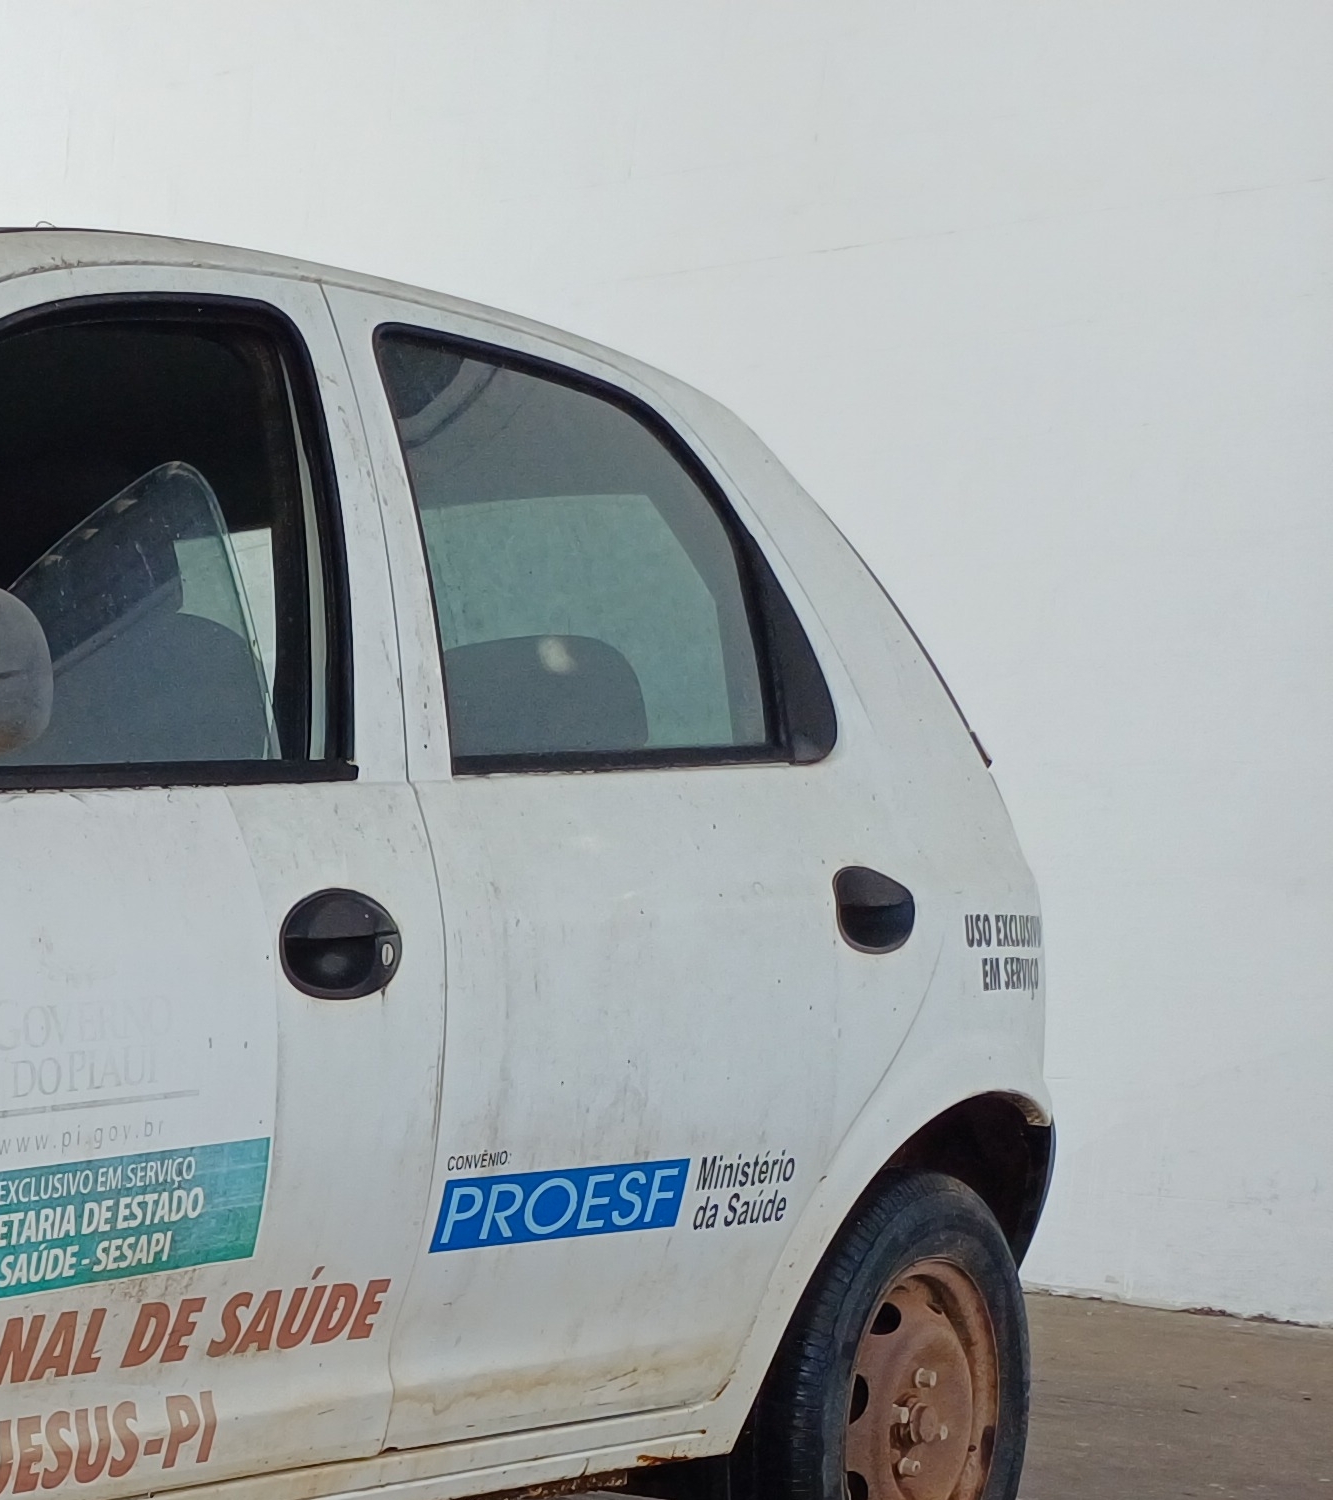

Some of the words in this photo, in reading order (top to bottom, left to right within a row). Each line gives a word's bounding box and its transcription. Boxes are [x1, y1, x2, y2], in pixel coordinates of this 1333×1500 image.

[964, 913, 992, 948] USO
[981, 957, 1001, 991] EM
[96, 1163, 123, 1193] EM
[125, 1155, 196, 1191] SERVIÇO
[446, 1149, 511, 1172] CONVÊNIO:
[695, 1150, 795, 1192] Ministério
[81, 1196, 114, 1236] DE
[117, 1186, 205, 1229] ESTADO
[439, 1167, 680, 1244] PROESF
[692, 1197, 718, 1231] da
[723, 1190, 787, 1227] Saúde
[91, 1230, 174, 1273] SESAPI
[119, 1296, 207, 1369] DE
[205, 1265, 392, 1358] SAÚDE
